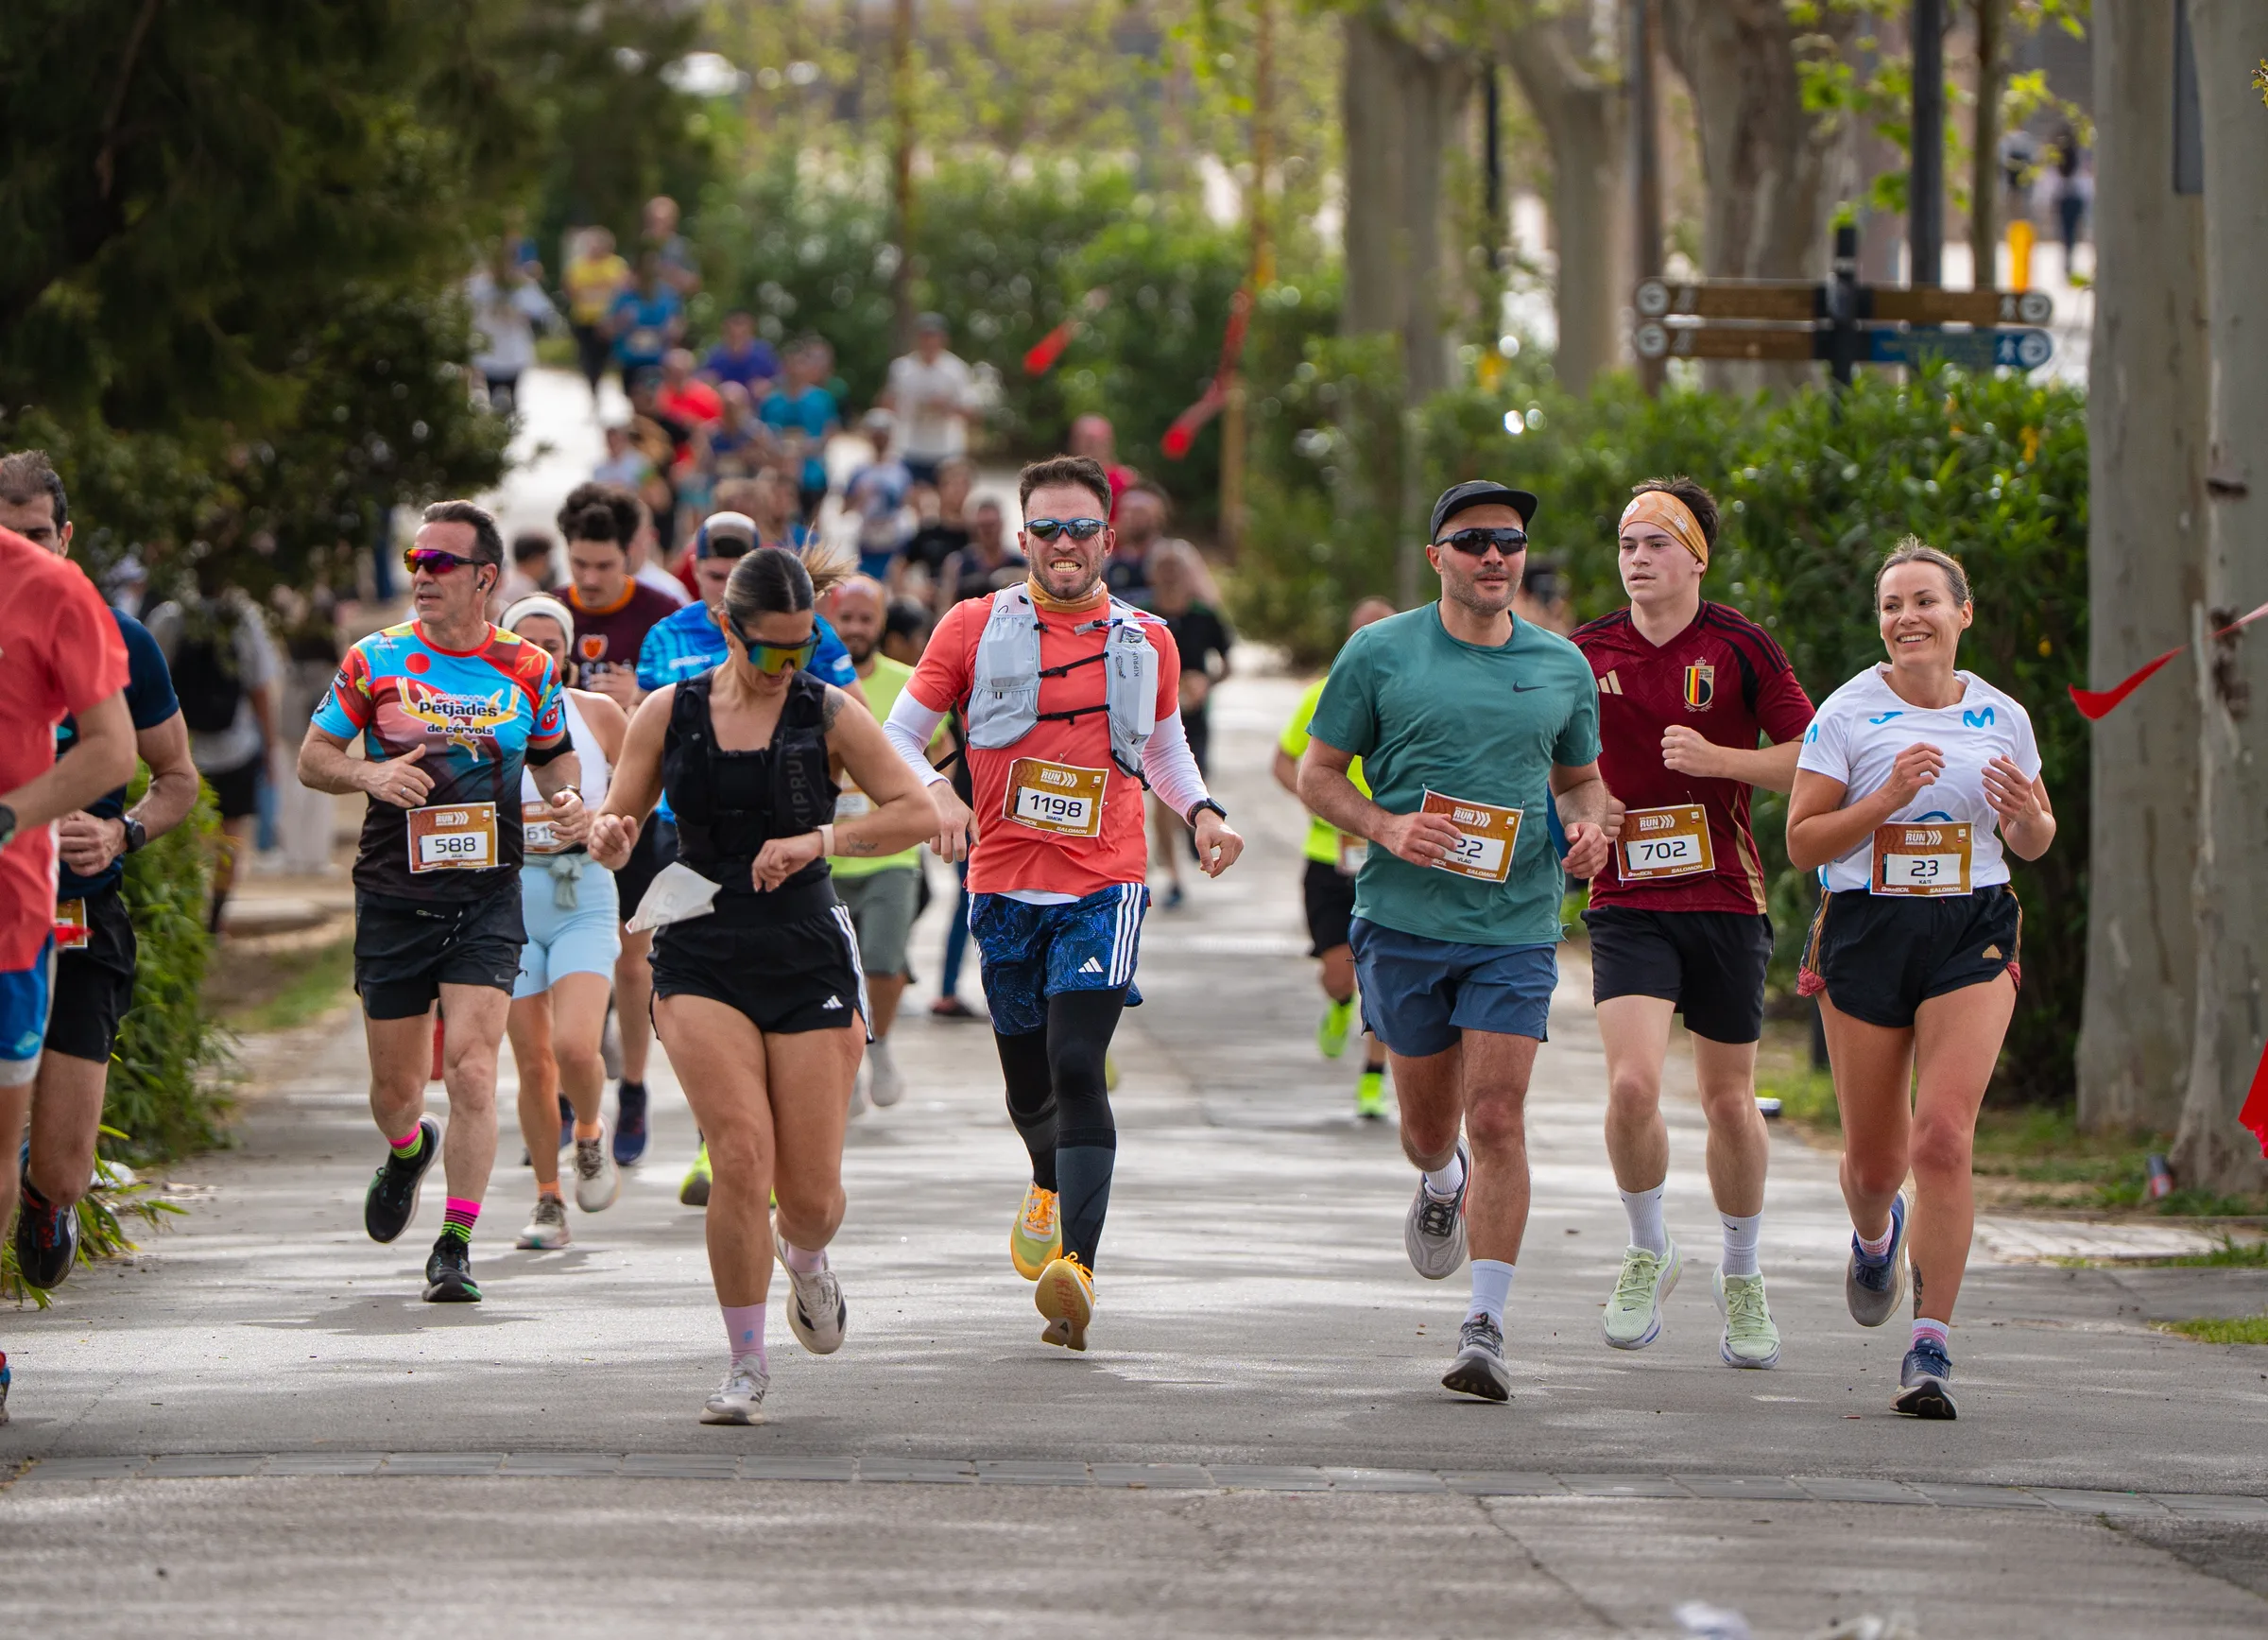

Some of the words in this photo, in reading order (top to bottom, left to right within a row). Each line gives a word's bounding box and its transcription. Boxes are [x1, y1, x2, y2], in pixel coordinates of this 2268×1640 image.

[419, 702, 498, 717] Petjades
[427, 724, 443, 733] de
[1041, 770, 1062, 783] RUN
[1030, 794, 1083, 818] 1198
[1452, 808, 1474, 821] RUN
[1640, 818, 1658, 828] RUN
[1056, 826, 1088, 835] SALOMON
[1905, 833, 1926, 841] RUN
[435, 837, 476, 854] 588
[1641, 841, 1687, 861] 702
[1466, 868, 1497, 878] SALOMON
[1672, 864, 1703, 873] SALOMON
[1911, 859, 1939, 877] 23
